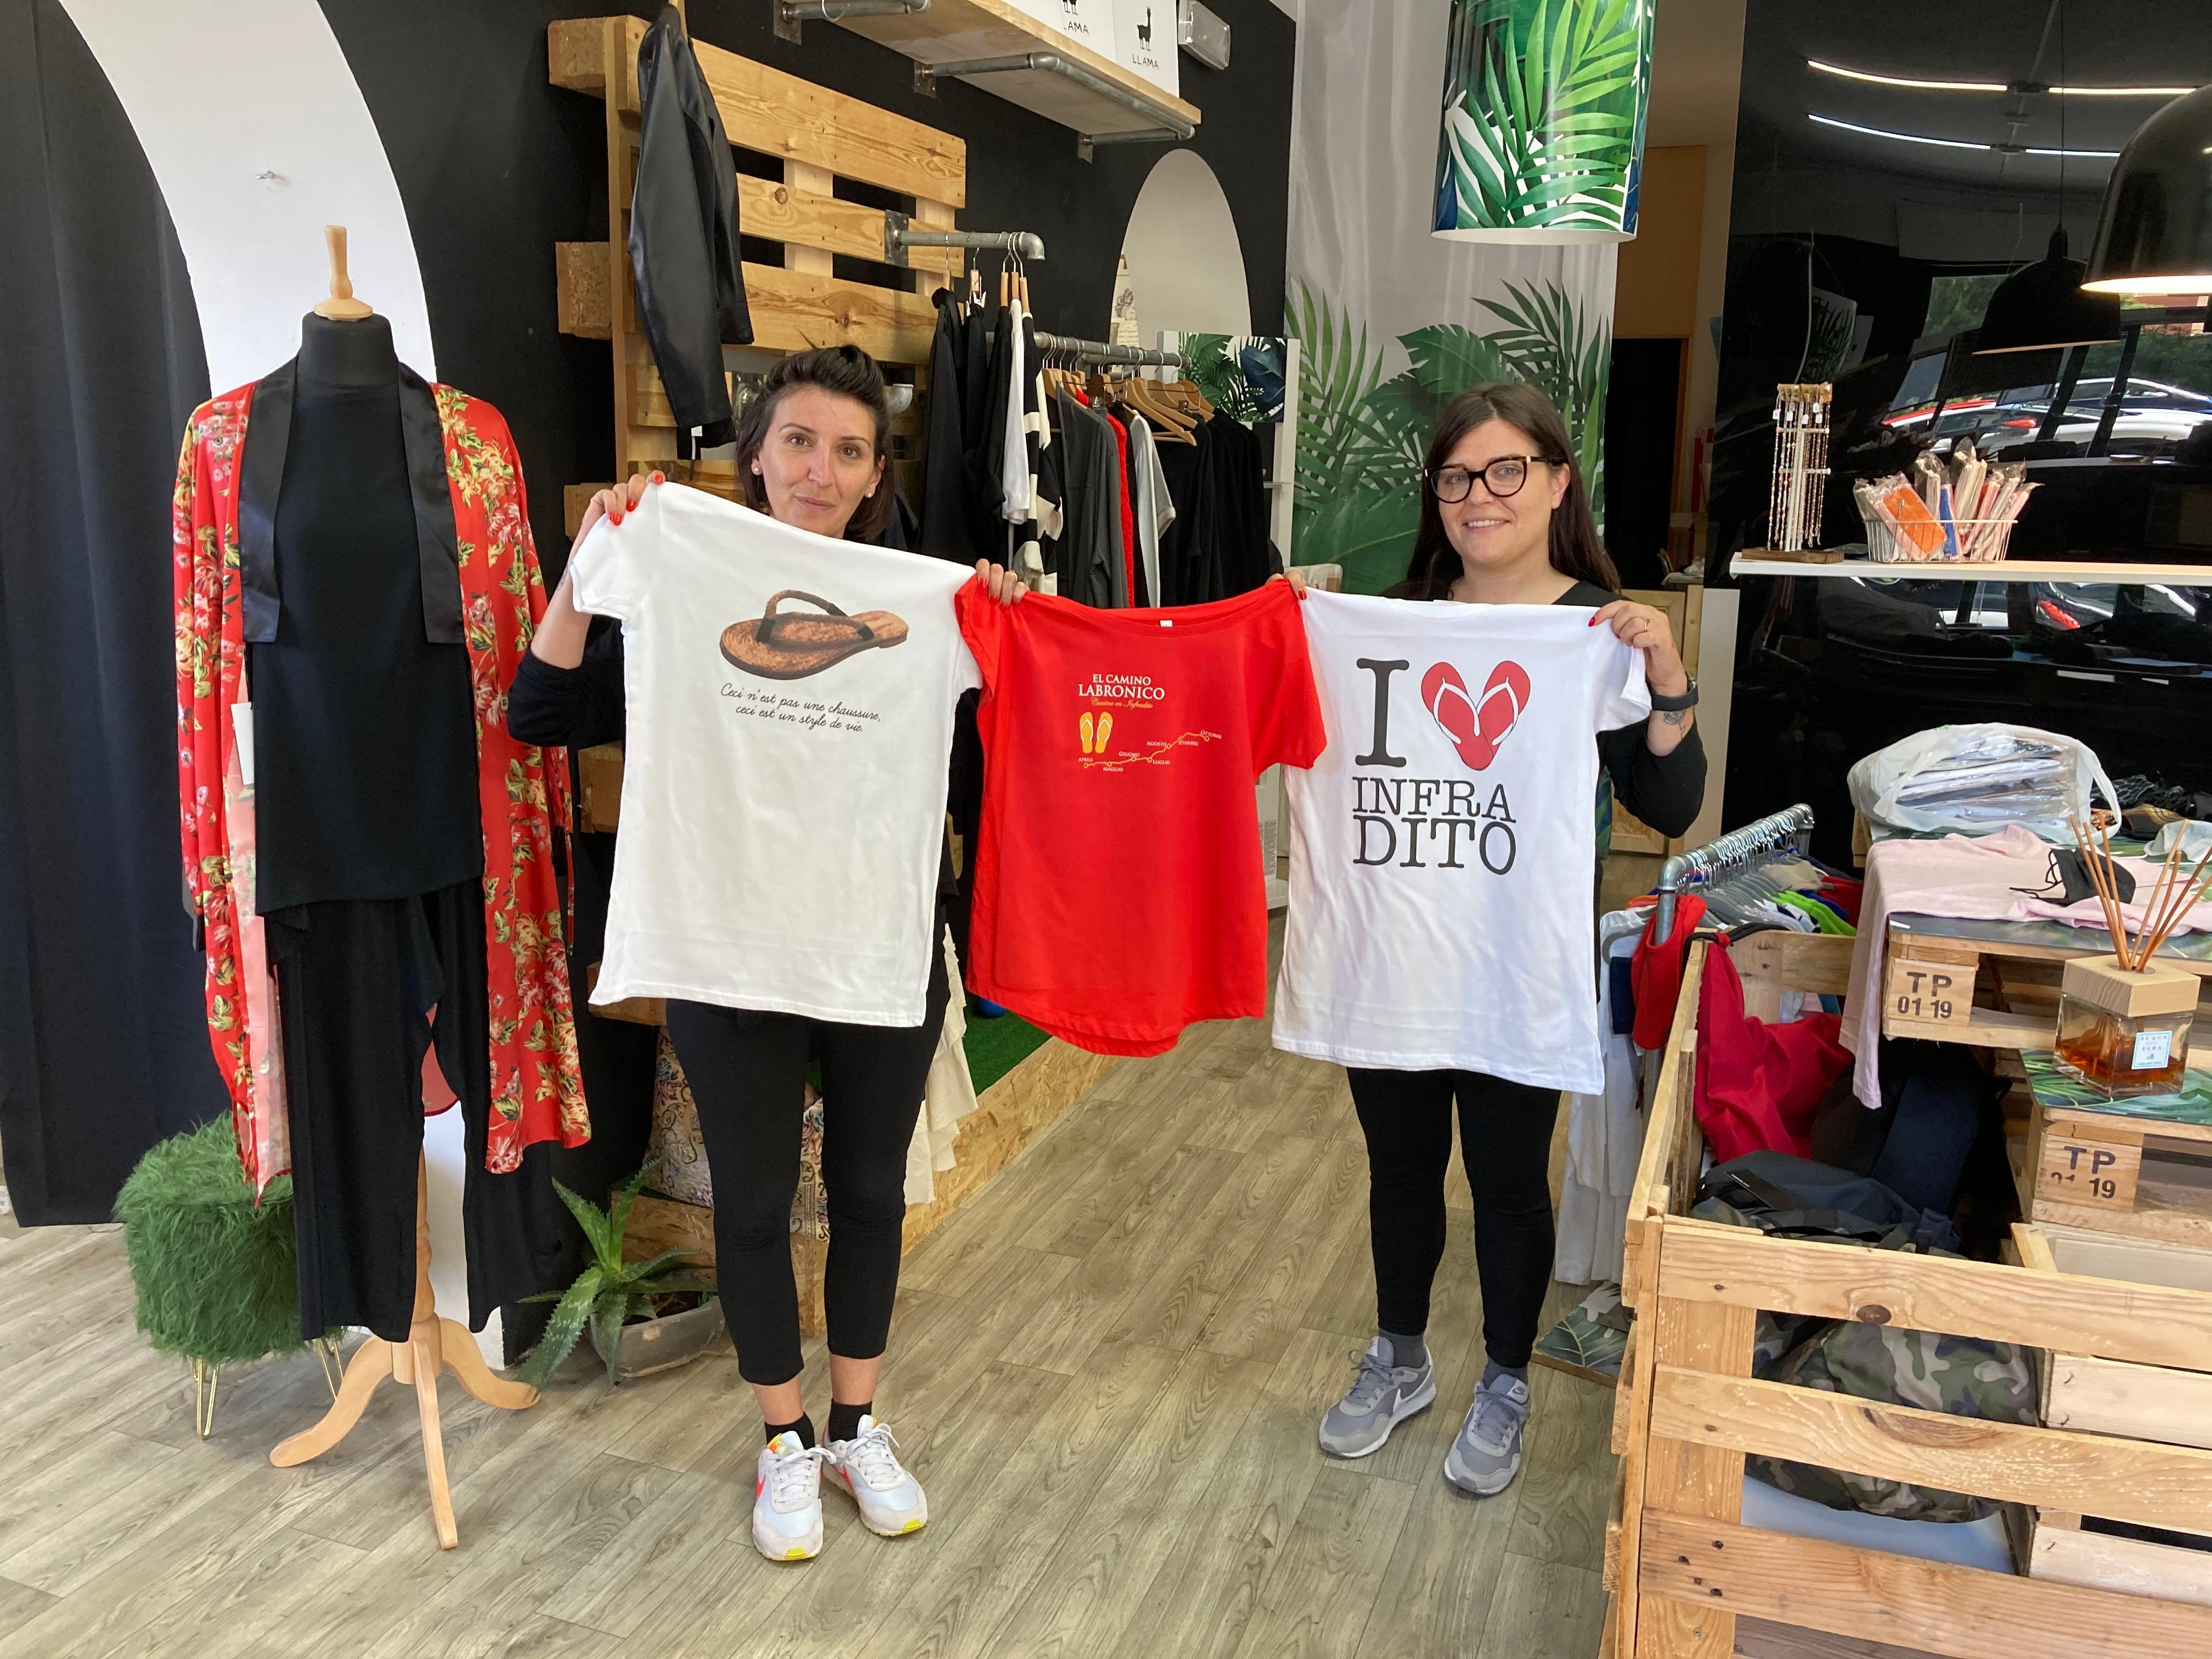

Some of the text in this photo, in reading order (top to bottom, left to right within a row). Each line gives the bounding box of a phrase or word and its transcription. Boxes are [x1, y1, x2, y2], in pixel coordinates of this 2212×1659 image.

[1132, 53, 1159, 70] LLAMA
[1078, 684, 1165, 701] LABRONICO
[1092, 674, 1152, 686] EL CAMINO
[721, 683, 881, 722] Ceci n'est pas une chaussure,
[1355, 658, 1409, 768] I
[736, 705, 864, 732] ceci est un style de vie.
[1352, 776, 1516, 823] INFRA
[1352, 815, 1516, 875] DITO
[2089, 1177, 2116, 1199] 19
